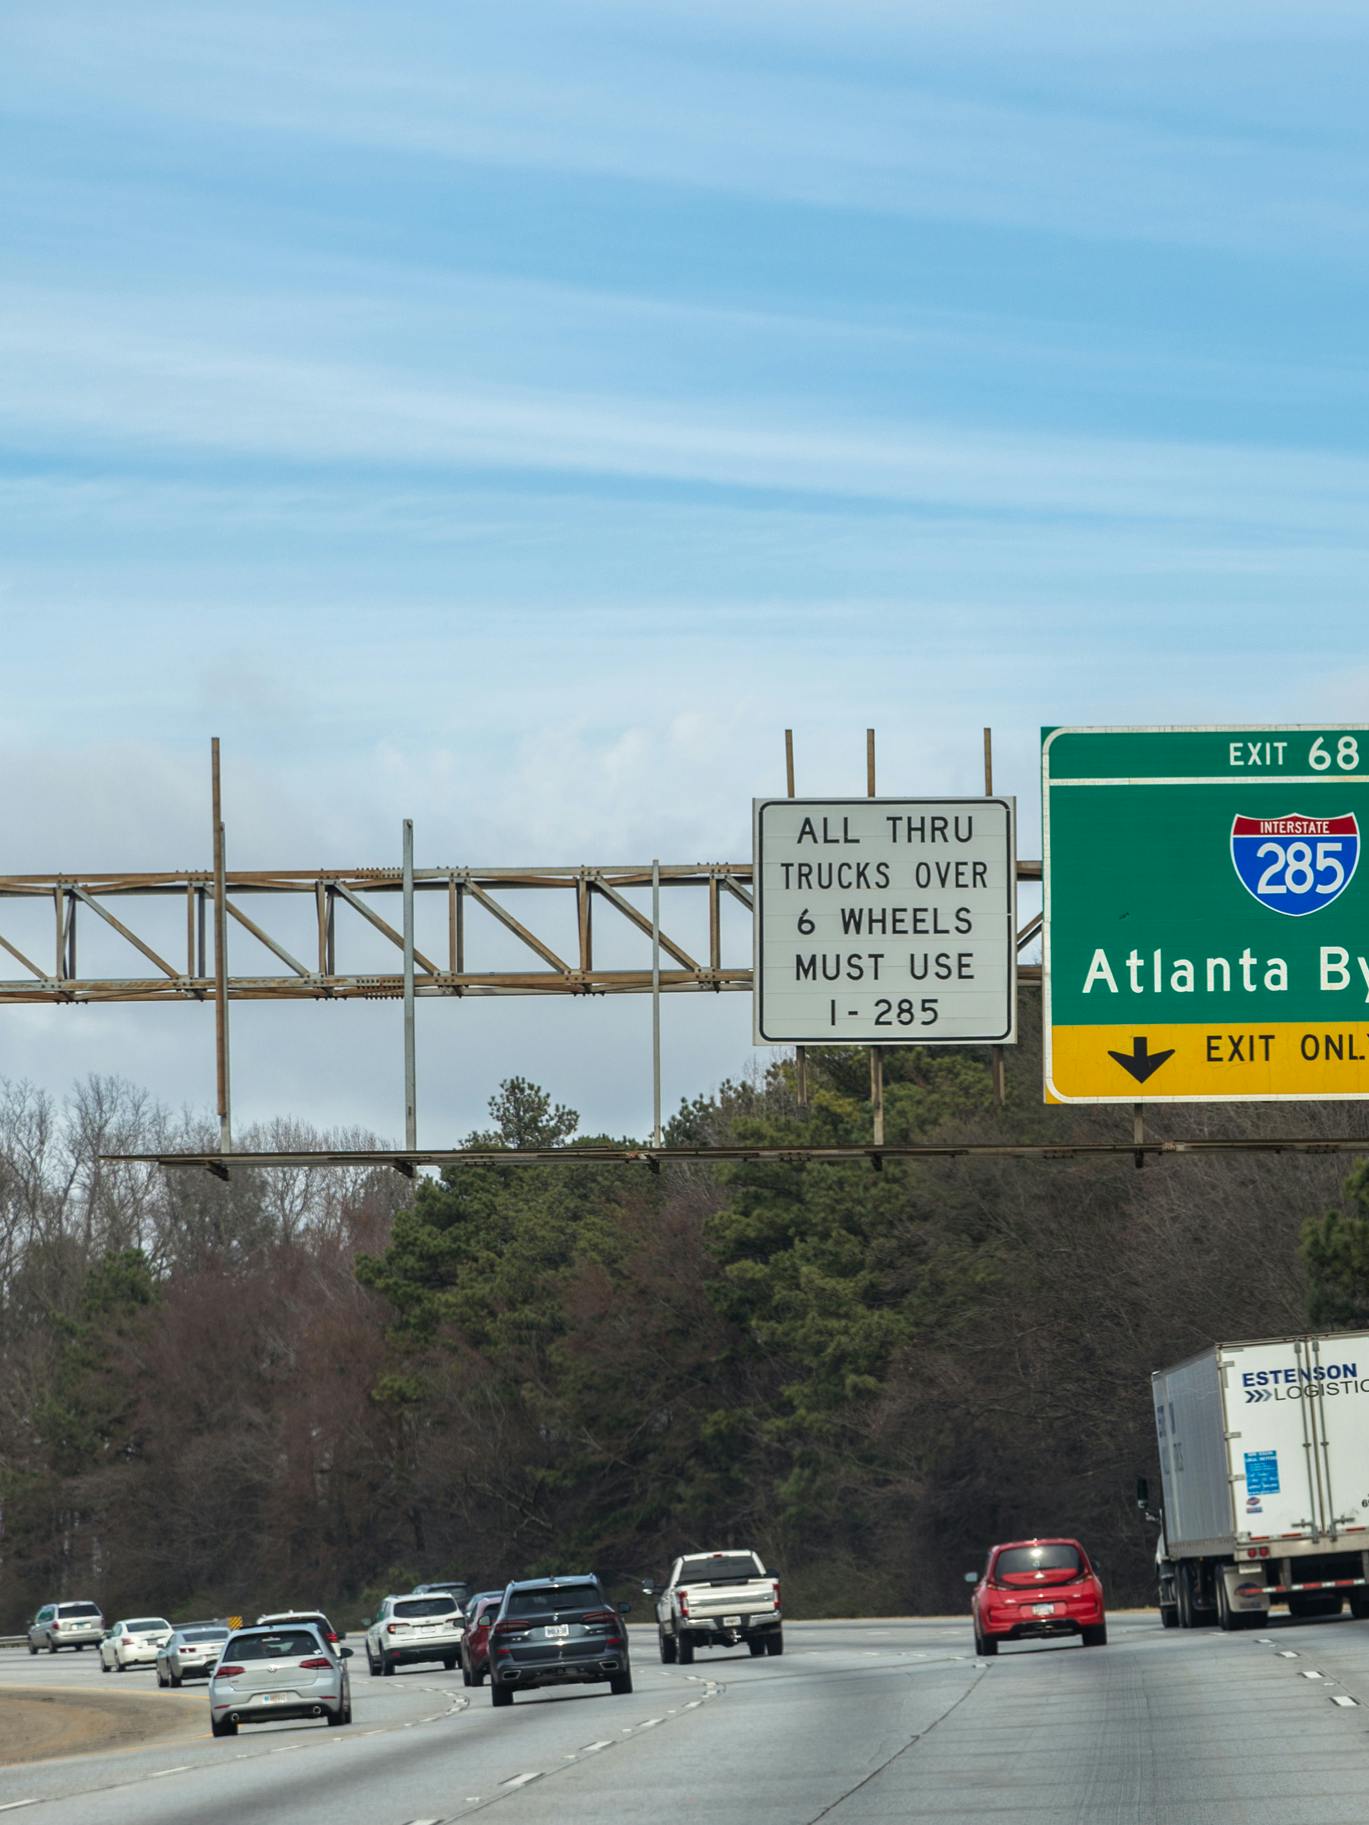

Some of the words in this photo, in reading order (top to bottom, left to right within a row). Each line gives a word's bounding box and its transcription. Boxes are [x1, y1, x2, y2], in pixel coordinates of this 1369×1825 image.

[1230, 743, 1287, 765] EXIT
[1307, 735, 1361, 771] 68
[797, 817, 860, 844] ALL
[887, 816, 972, 843] THRU
[1259, 819, 1331, 836] INTERSTATE
[781, 863, 889, 889] TRUCKS
[916, 862, 987, 888] OVER
[1256, 842, 1344, 895] 285
[798, 909, 815, 935] 6
[841, 907, 971, 934] WHEELS
[796, 954, 884, 980] MUST
[911, 953, 974, 980] USE
[1083, 948, 1287, 993] Atlanta
[1207, 1035, 1275, 1062] EXIT
[1242, 1363, 1358, 1388] ESTENSON
